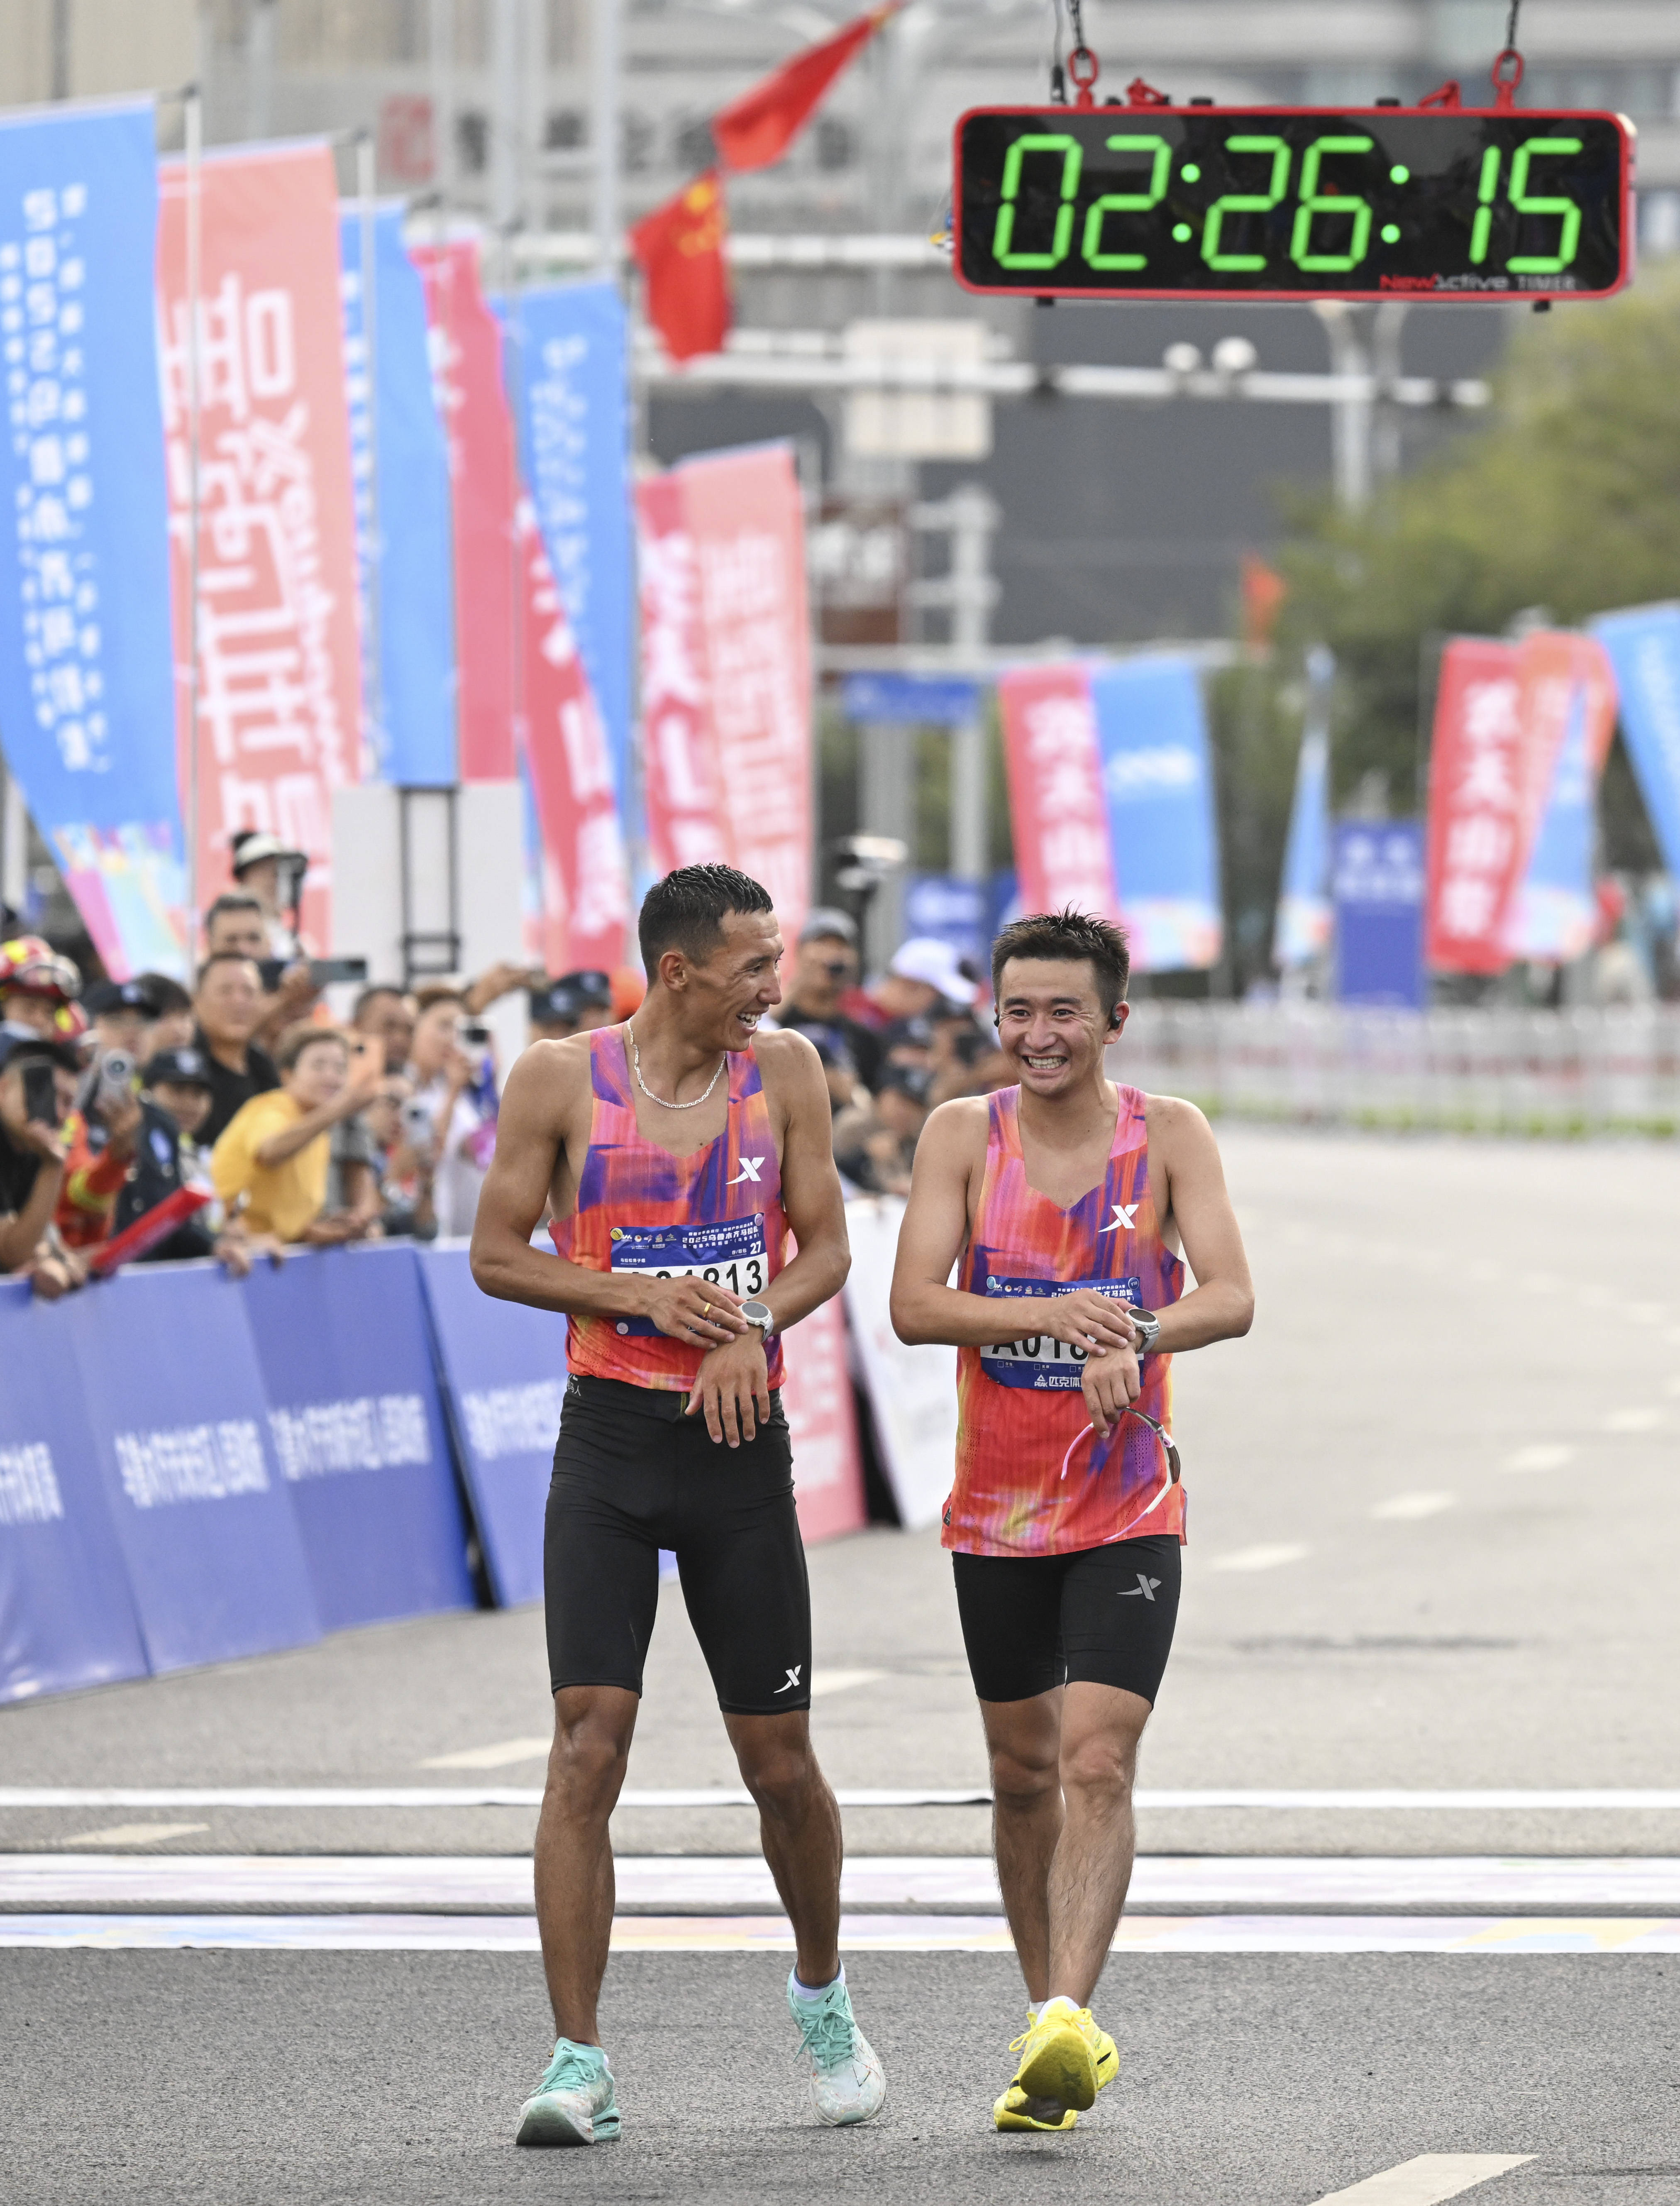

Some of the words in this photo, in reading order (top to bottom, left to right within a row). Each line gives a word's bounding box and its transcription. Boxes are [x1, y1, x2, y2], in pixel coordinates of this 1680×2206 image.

[994, 134, 1582, 272] 02:26:15
[750, 1241, 761, 1254] 27
[632, 1260, 762, 1295] 813
[1049, 1376, 1081, 1388] 匹克体
